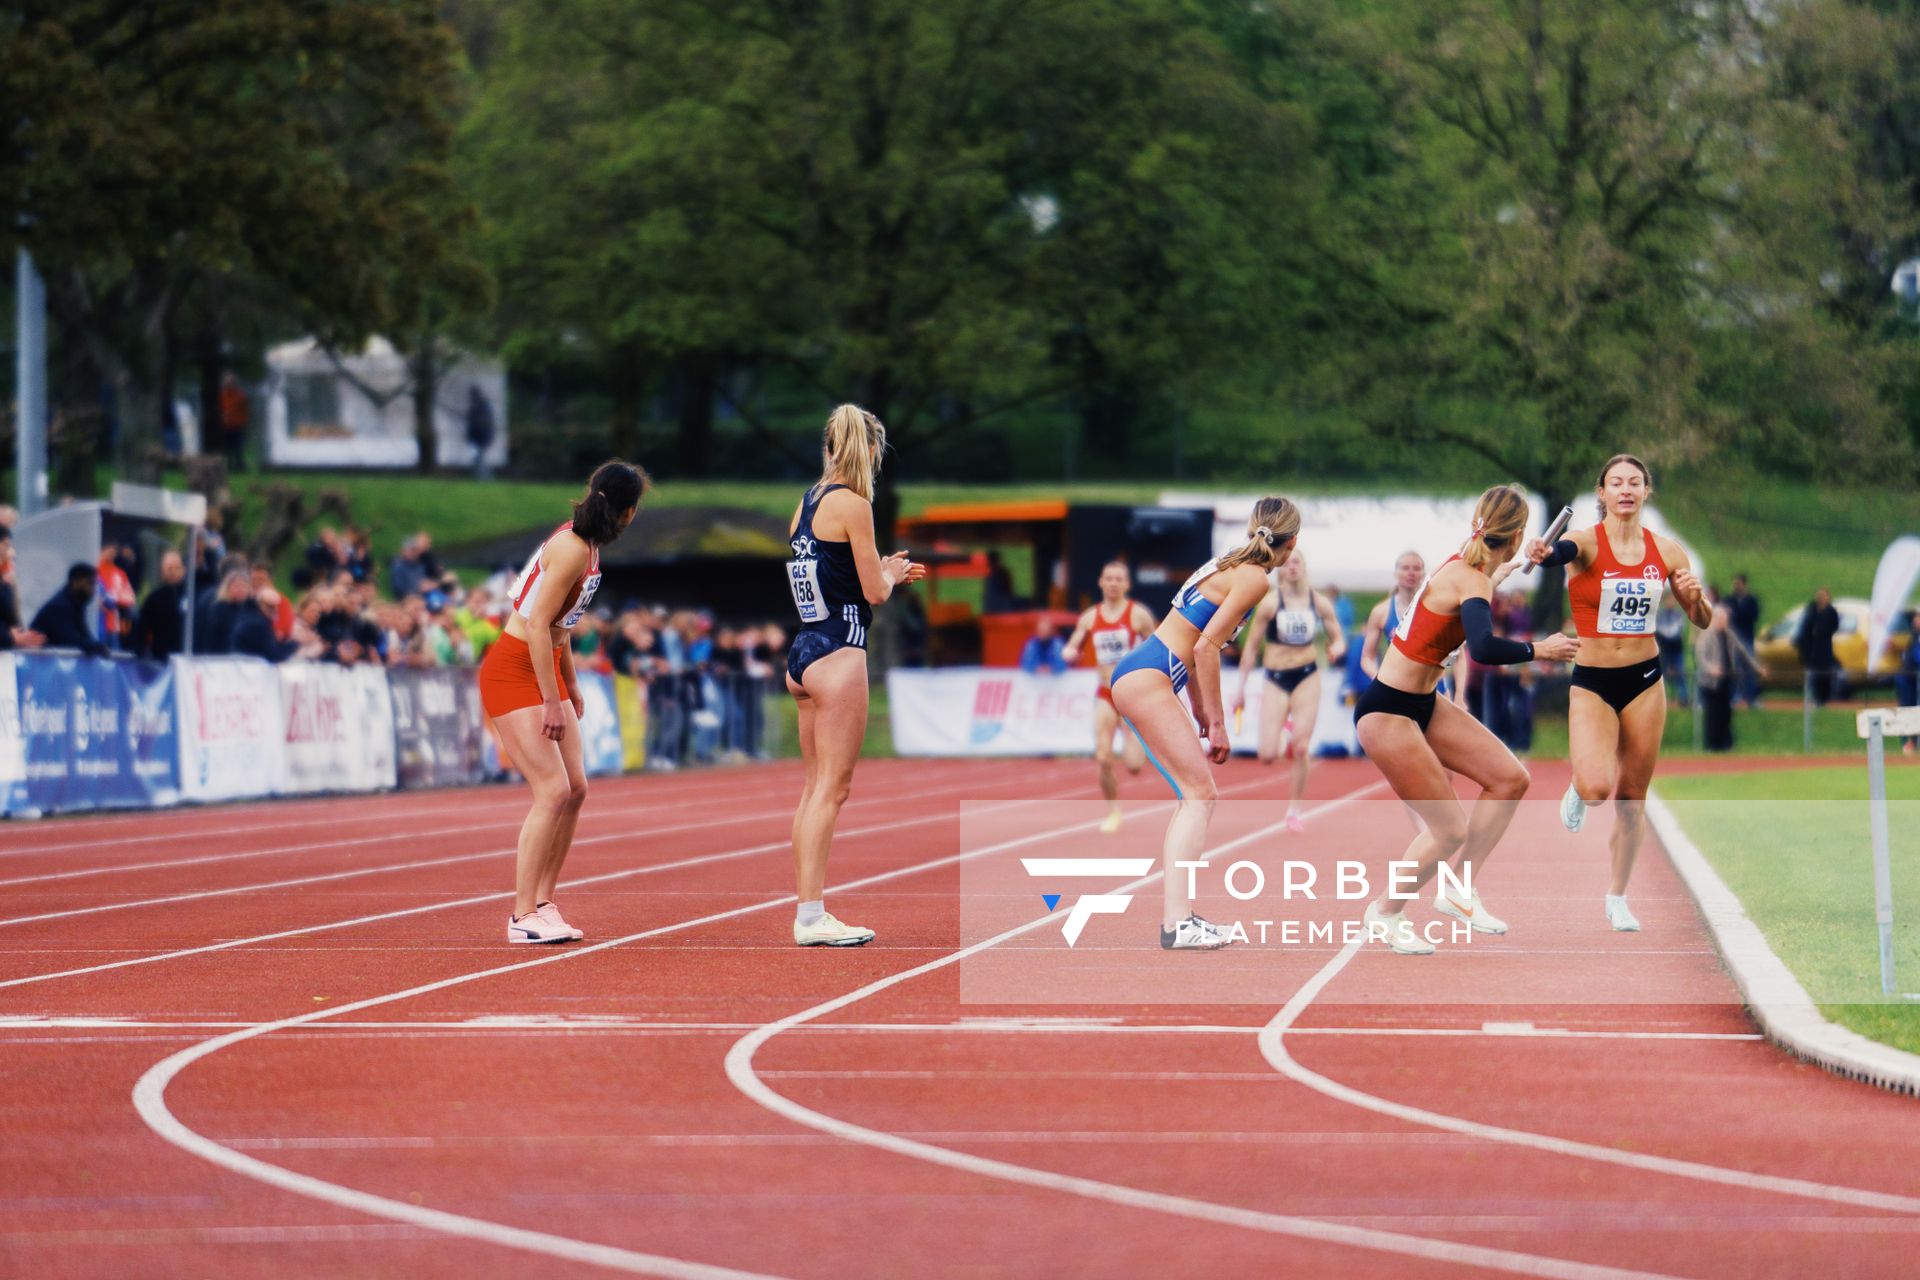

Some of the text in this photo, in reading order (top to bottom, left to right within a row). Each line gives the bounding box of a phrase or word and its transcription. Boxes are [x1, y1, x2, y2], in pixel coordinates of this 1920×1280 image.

[793, 565, 807, 578] GLS
[794, 581, 814, 602] 158
[1615, 582, 1646, 595] GLS
[1610, 596, 1651, 617] 495
